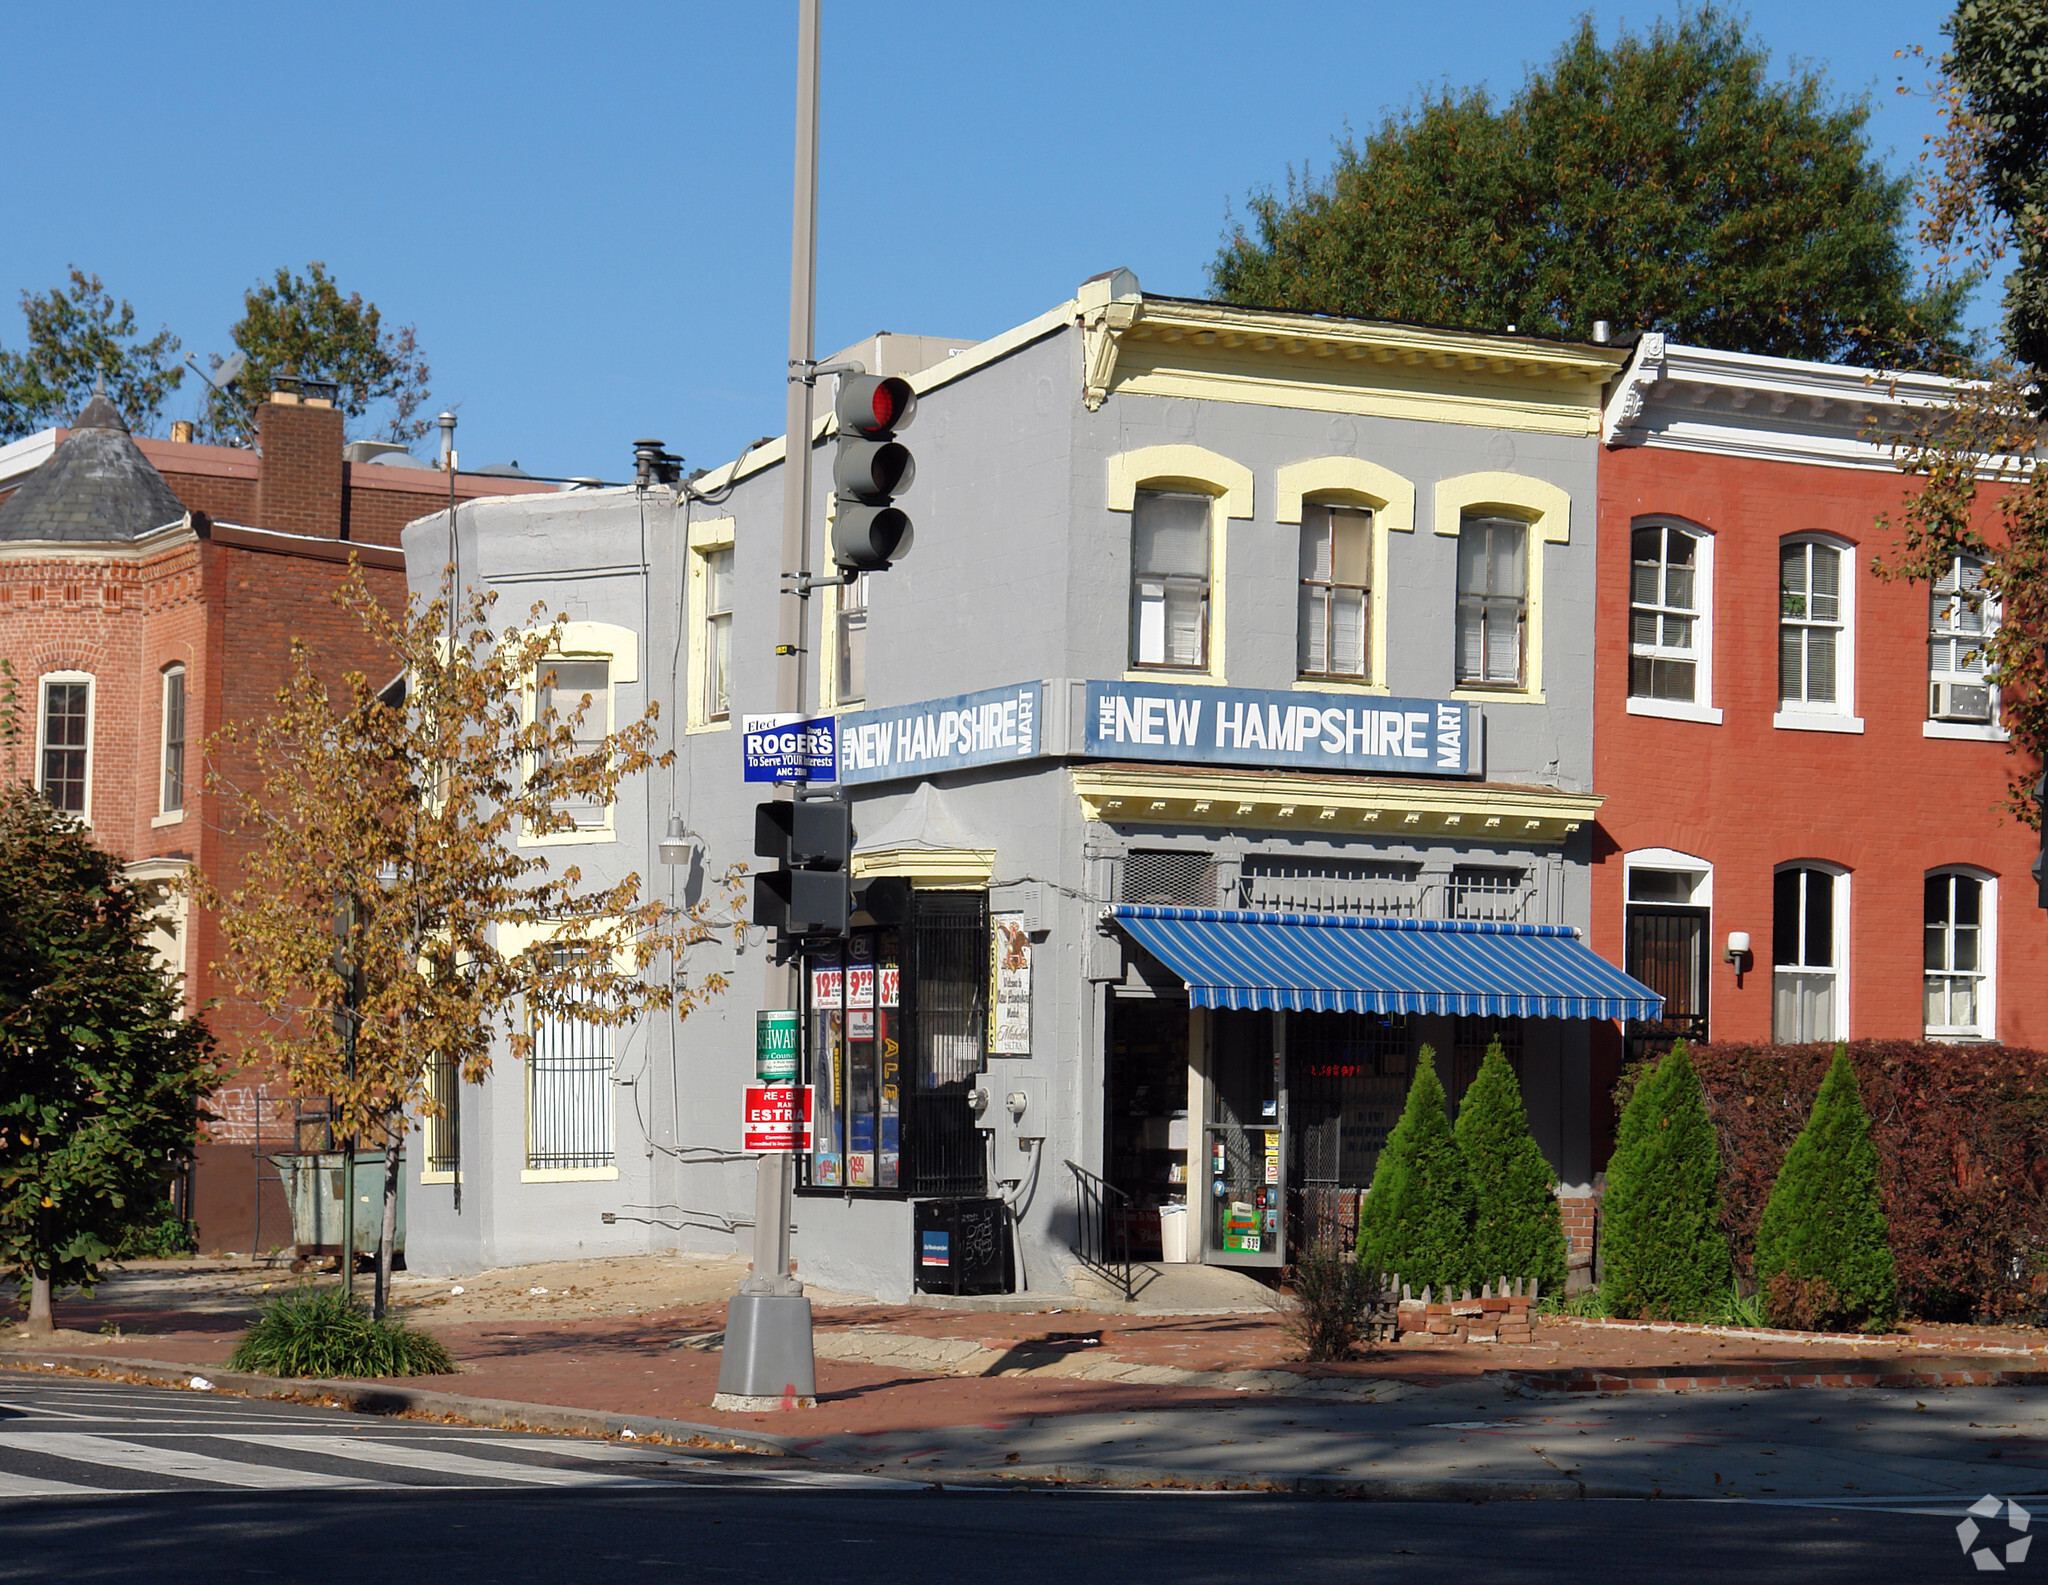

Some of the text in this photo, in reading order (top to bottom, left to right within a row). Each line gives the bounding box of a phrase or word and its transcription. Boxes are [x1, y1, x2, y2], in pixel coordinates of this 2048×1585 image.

[748, 718, 776, 732] Elect
[822, 726, 832, 735] A.
[842, 689, 1034, 771] THE NEW HAMPSHIRE MART
[1099, 696, 1462, 768] THE NEW HAMPSHIRE MART
[747, 733, 833, 755] ROGERS
[748, 757, 759, 767] To
[760, 757, 781, 767] Serve
[781, 755, 803, 766] YOUR
[776, 767, 793, 776] ANC
